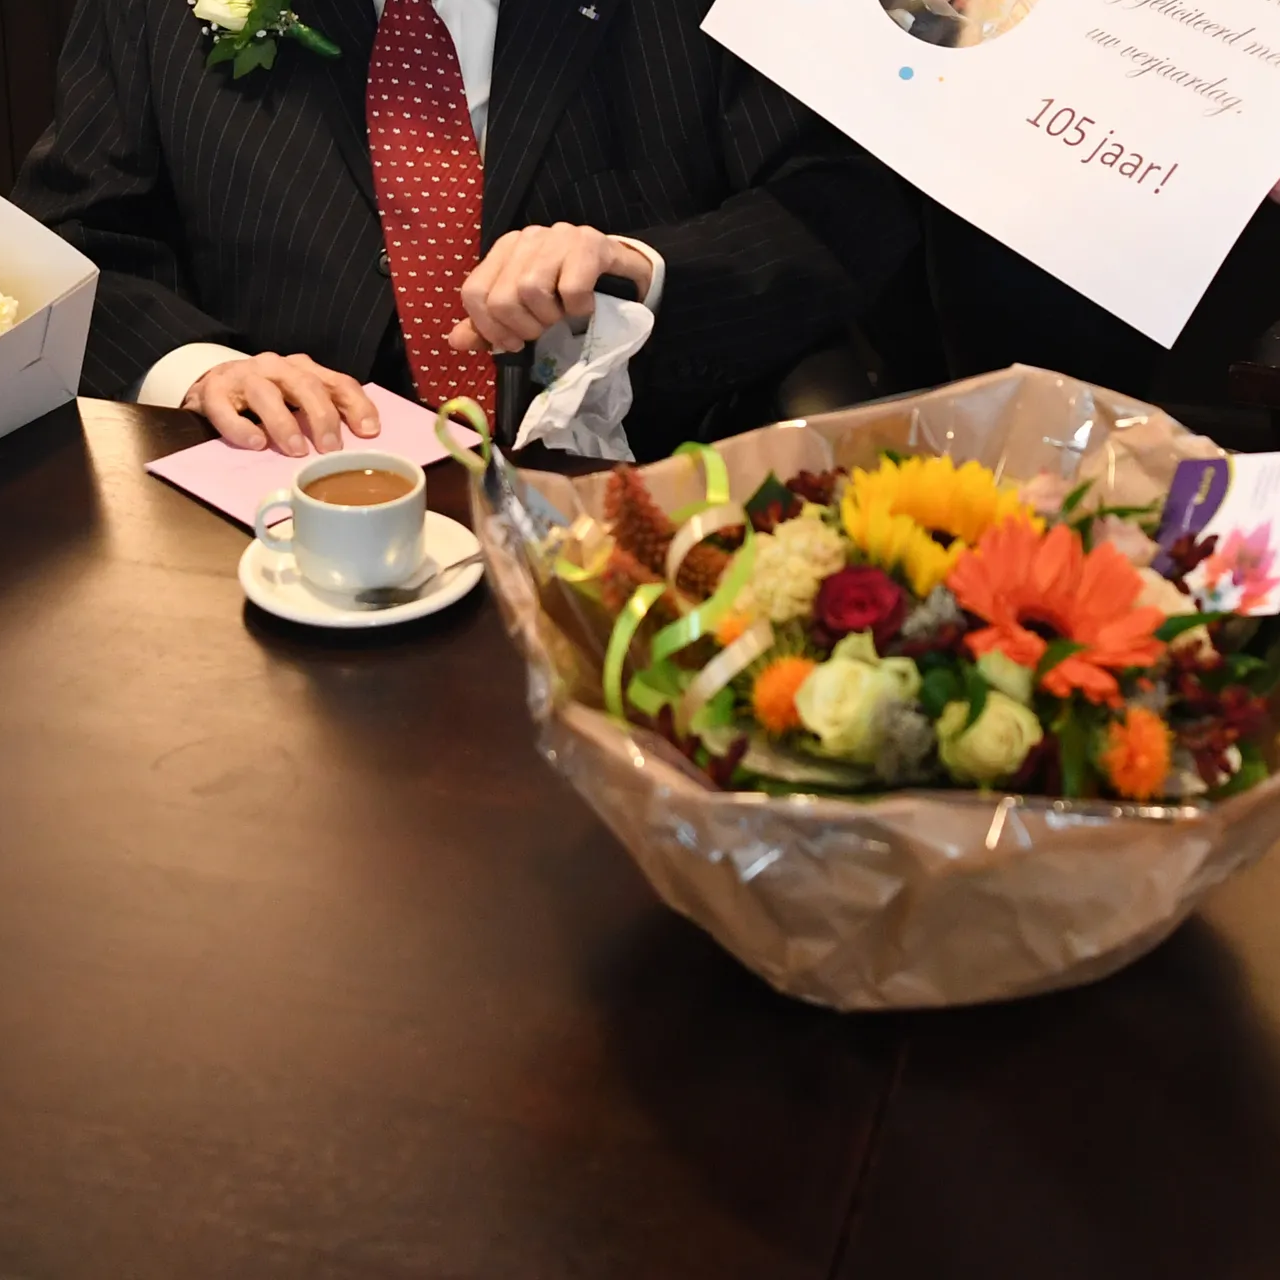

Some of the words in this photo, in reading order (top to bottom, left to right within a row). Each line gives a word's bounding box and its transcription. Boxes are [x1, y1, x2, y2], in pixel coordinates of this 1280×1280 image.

[1084, 26, 1123, 50] uw
[1120, 44, 1245, 118] verjaardag.
[1025, 96, 1095, 148] 105
[1080, 129, 1179, 195] jaar!
